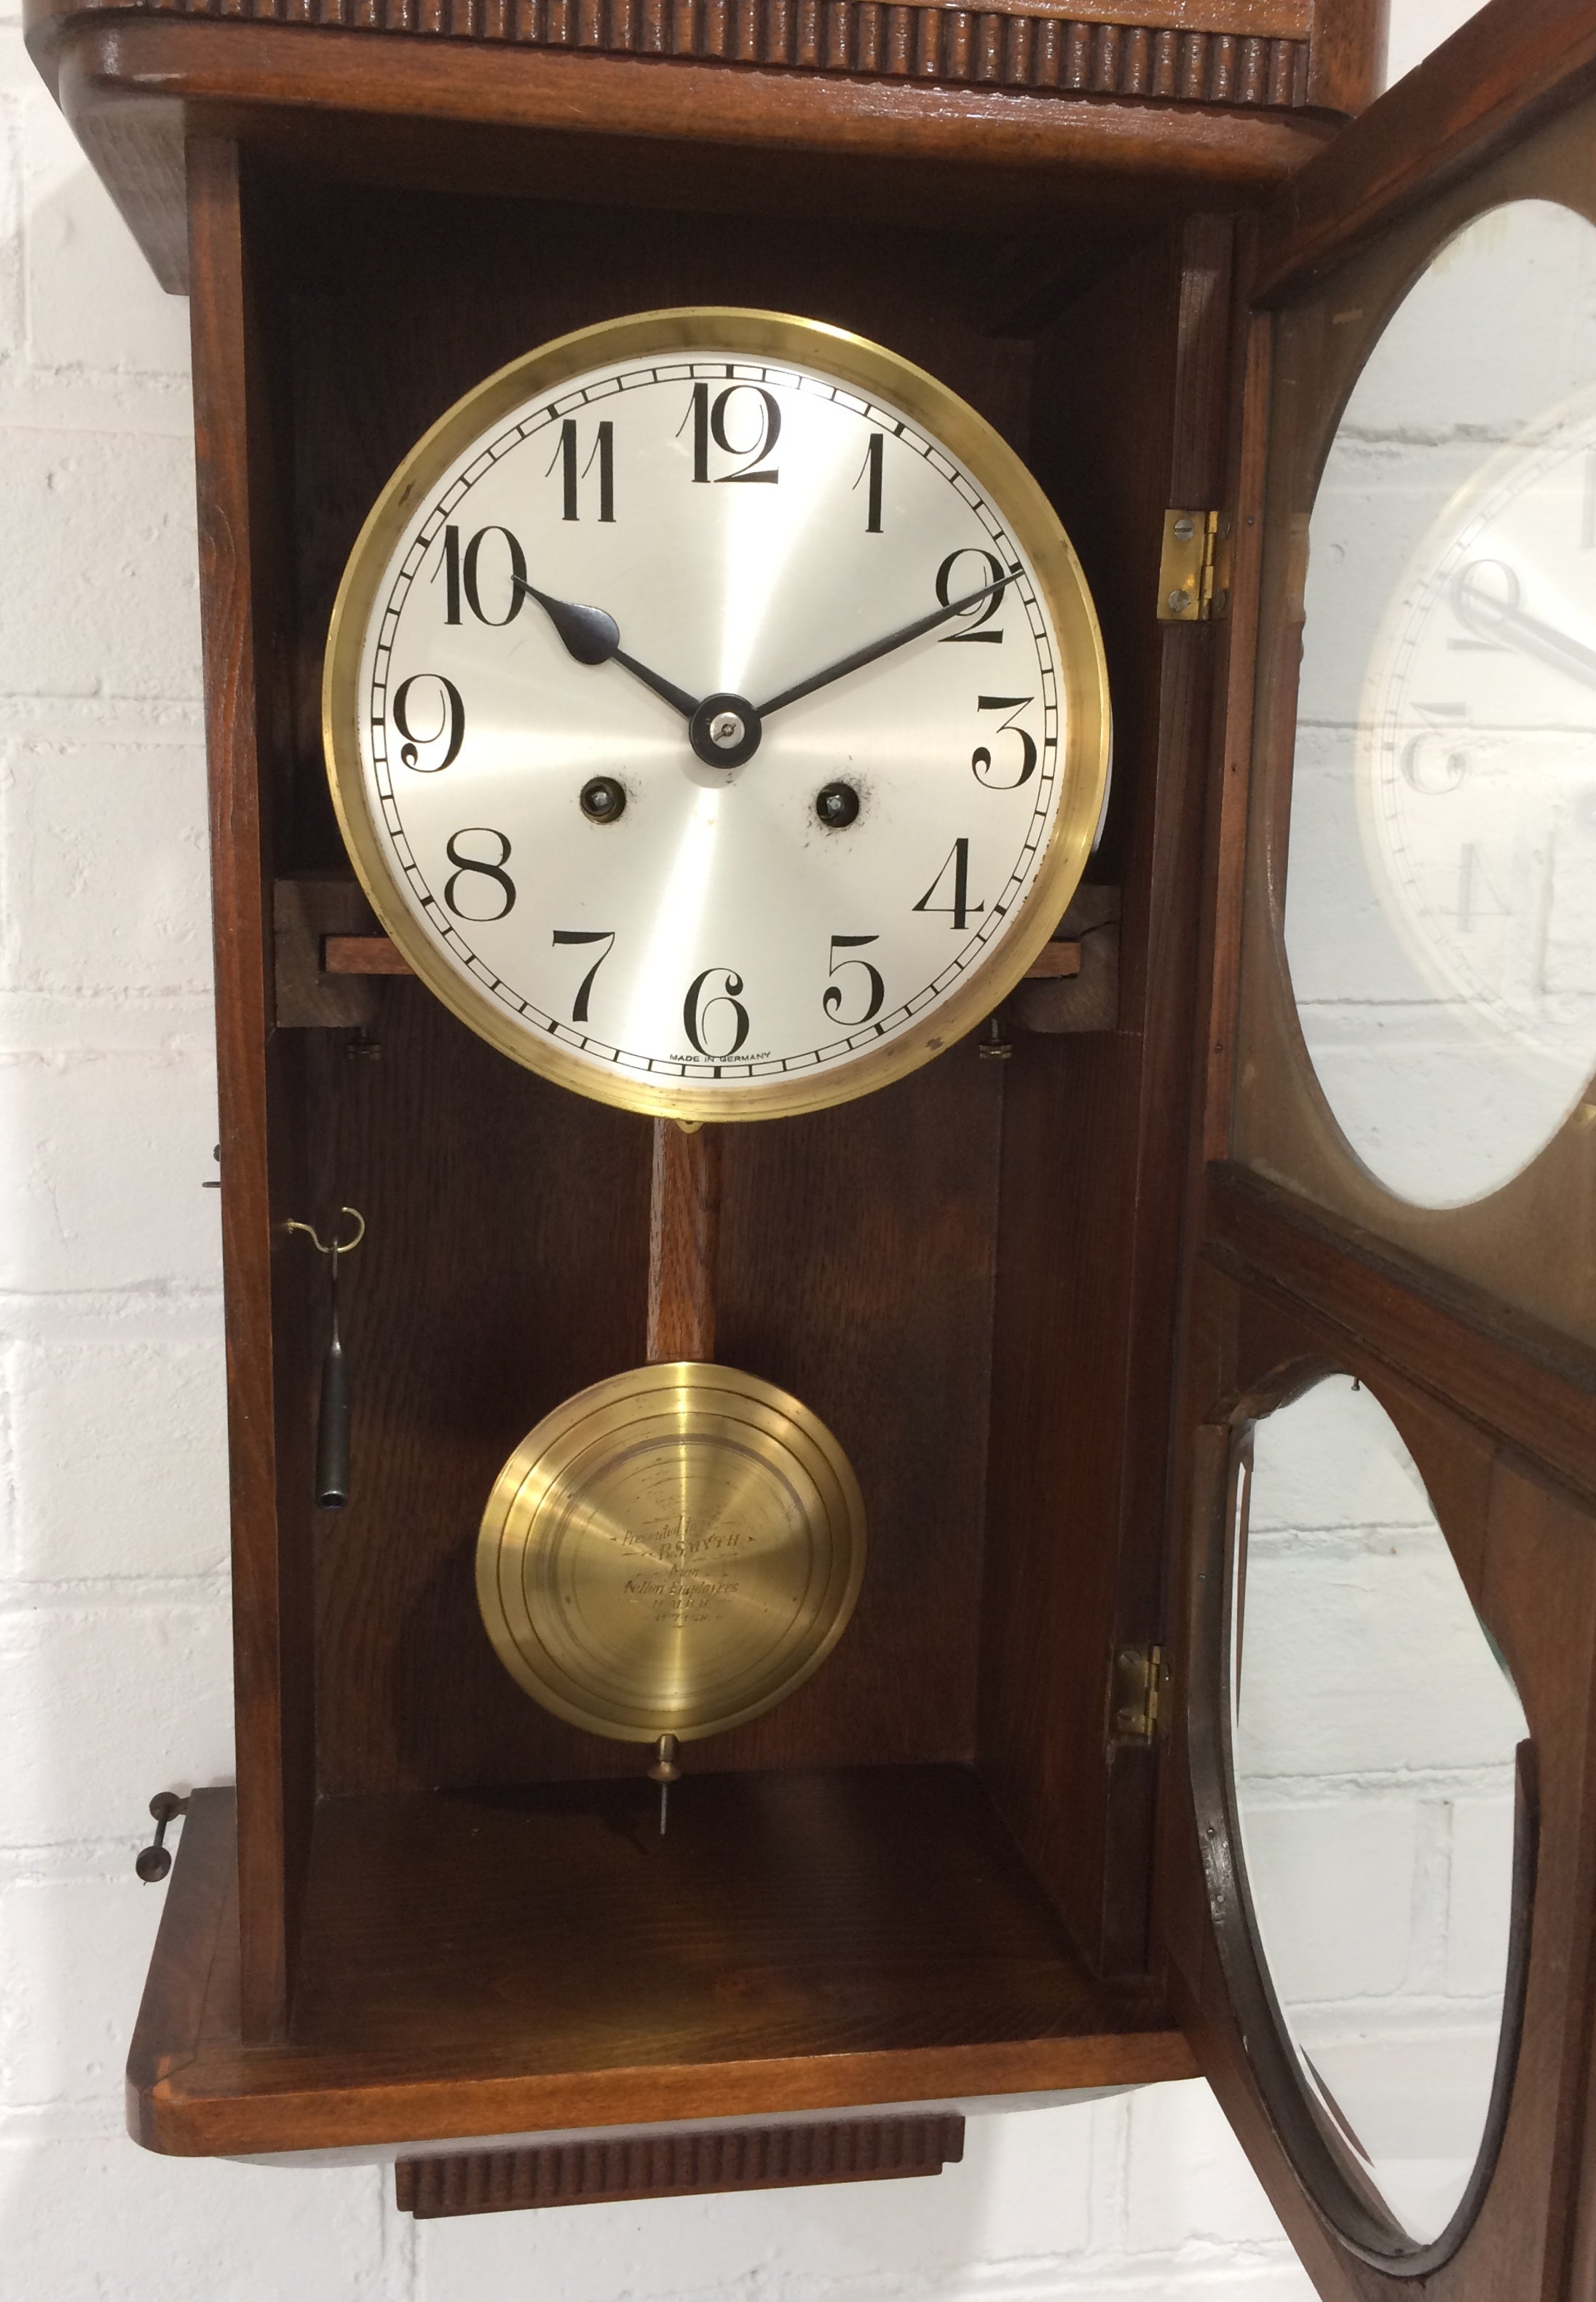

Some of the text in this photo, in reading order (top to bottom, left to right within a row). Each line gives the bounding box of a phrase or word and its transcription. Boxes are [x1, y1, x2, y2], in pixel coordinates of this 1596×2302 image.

[545, 419, 617, 523] 11
[676, 382, 782, 484] 12
[853, 433, 884, 533] 1
[430, 524, 528, 627] 10
[936, 548, 1006, 644] 2
[393, 674, 465, 773] 9
[972, 695, 1038, 790] 3
[444, 827, 517, 922] 8
[912, 837, 985, 930] 4
[552, 930, 616, 1022] 7
[684, 967, 750, 1058] 6
[823, 935, 885, 1026] 5
[669, 1054, 700, 1063] MADE
[719, 1051, 771, 1063] GERMANY
